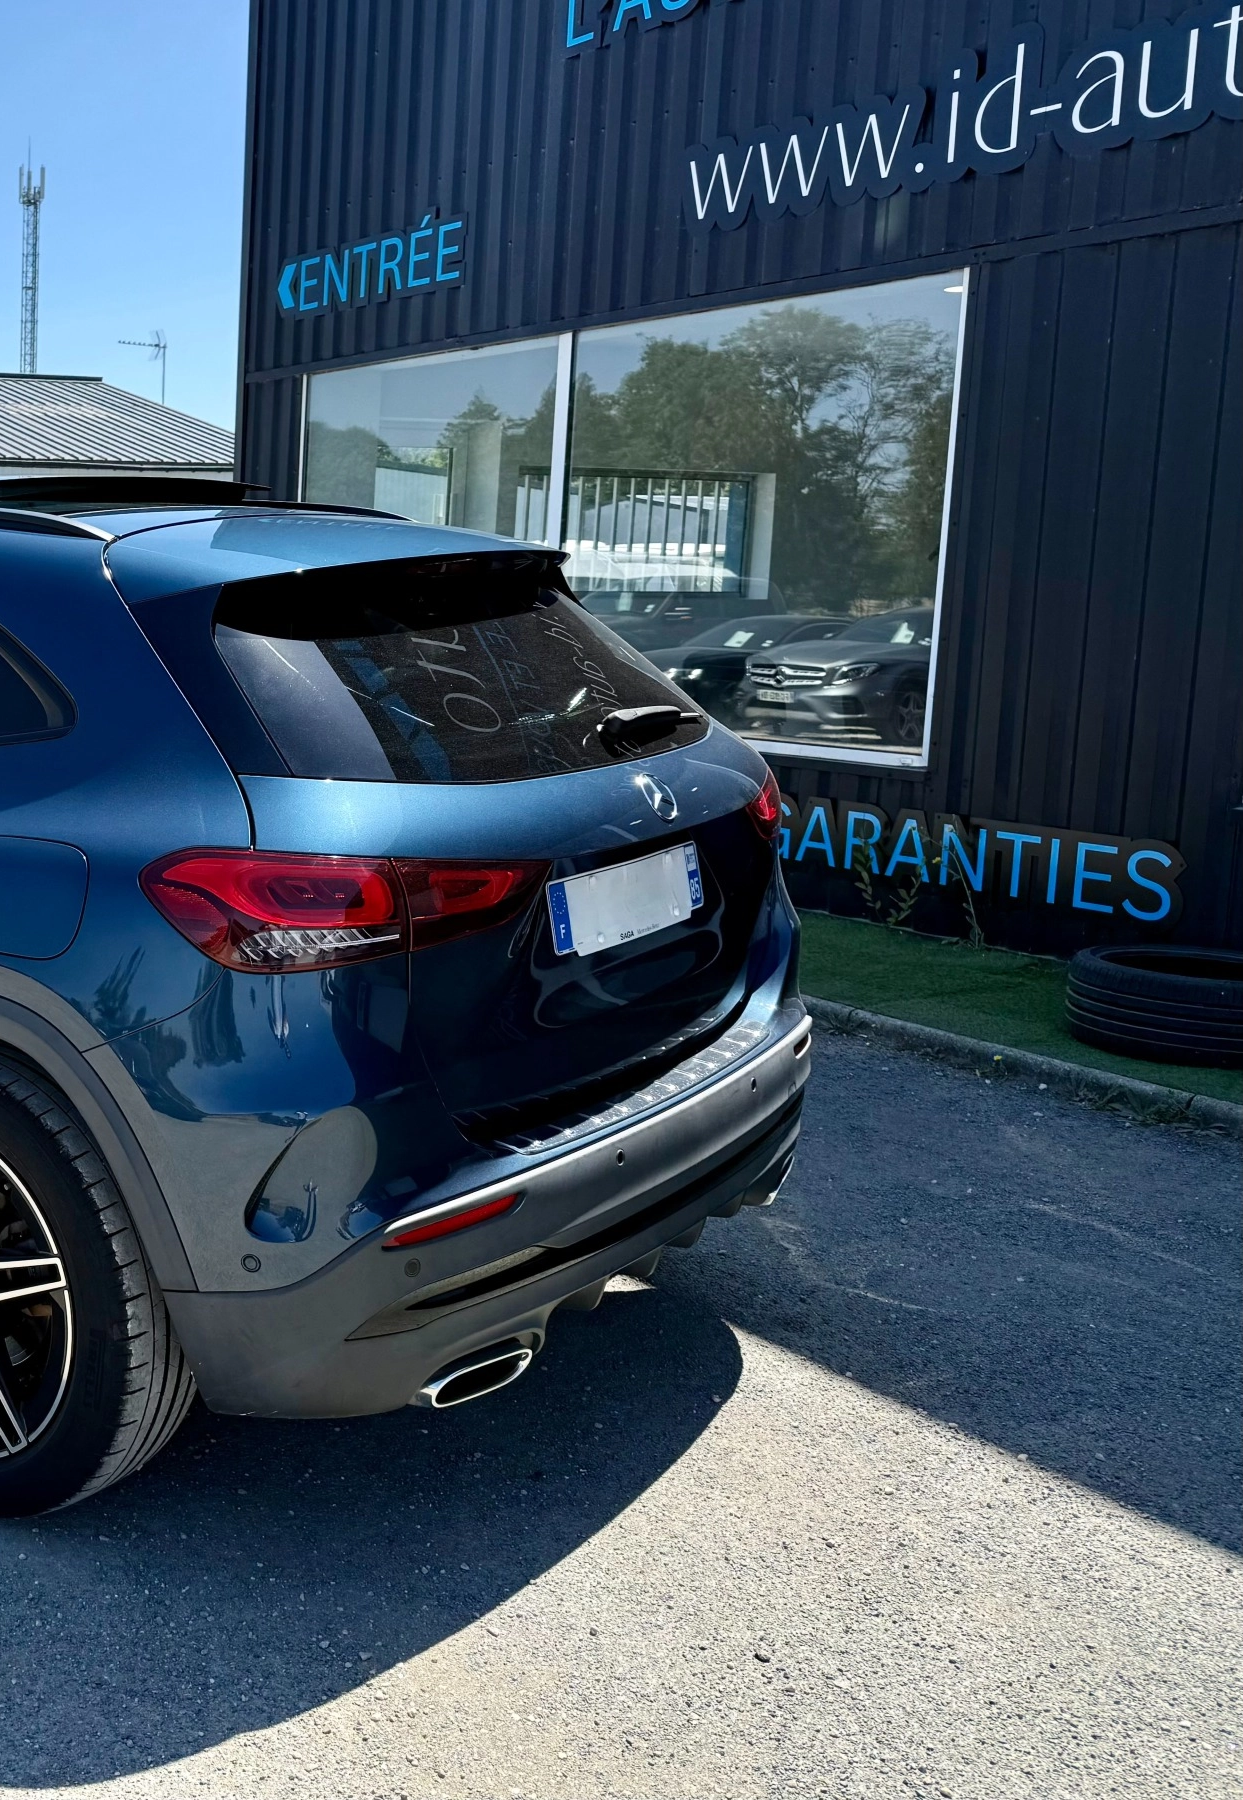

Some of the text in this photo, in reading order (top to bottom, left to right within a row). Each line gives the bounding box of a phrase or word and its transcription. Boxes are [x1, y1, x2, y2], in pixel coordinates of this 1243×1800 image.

[690, 5, 1243, 220] www.id-aut
[300, 215, 462, 311] ENTRÉE
[690, 877, 700, 900] 85
[560, 924, 566, 939] F
[620, 931, 634, 940] SAGA
